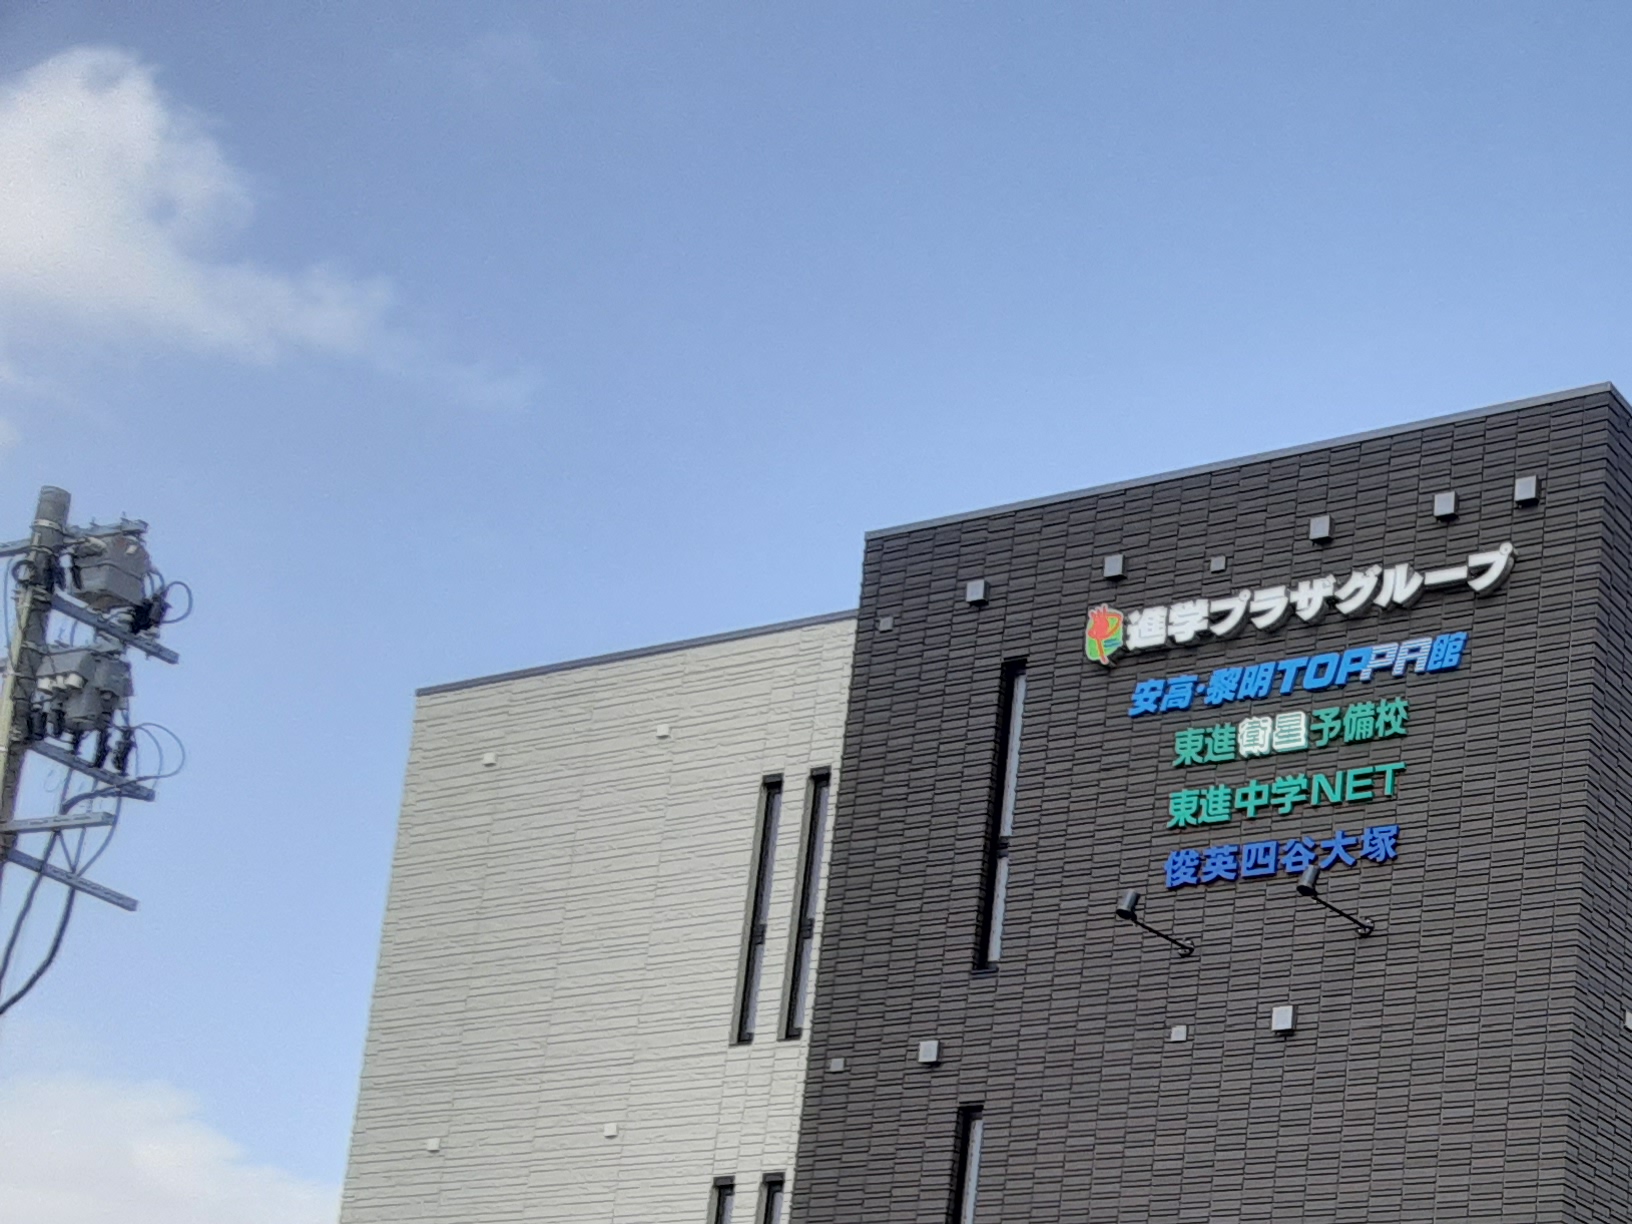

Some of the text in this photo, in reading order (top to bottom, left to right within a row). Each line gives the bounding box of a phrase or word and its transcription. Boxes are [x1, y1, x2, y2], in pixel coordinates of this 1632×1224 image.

[1126, 542, 1516, 650] 進学プラザグループ
[1172, 697, 1410, 768] 東進衛星予備校
[1163, 825, 1400, 890] 俊英四谷大塚
